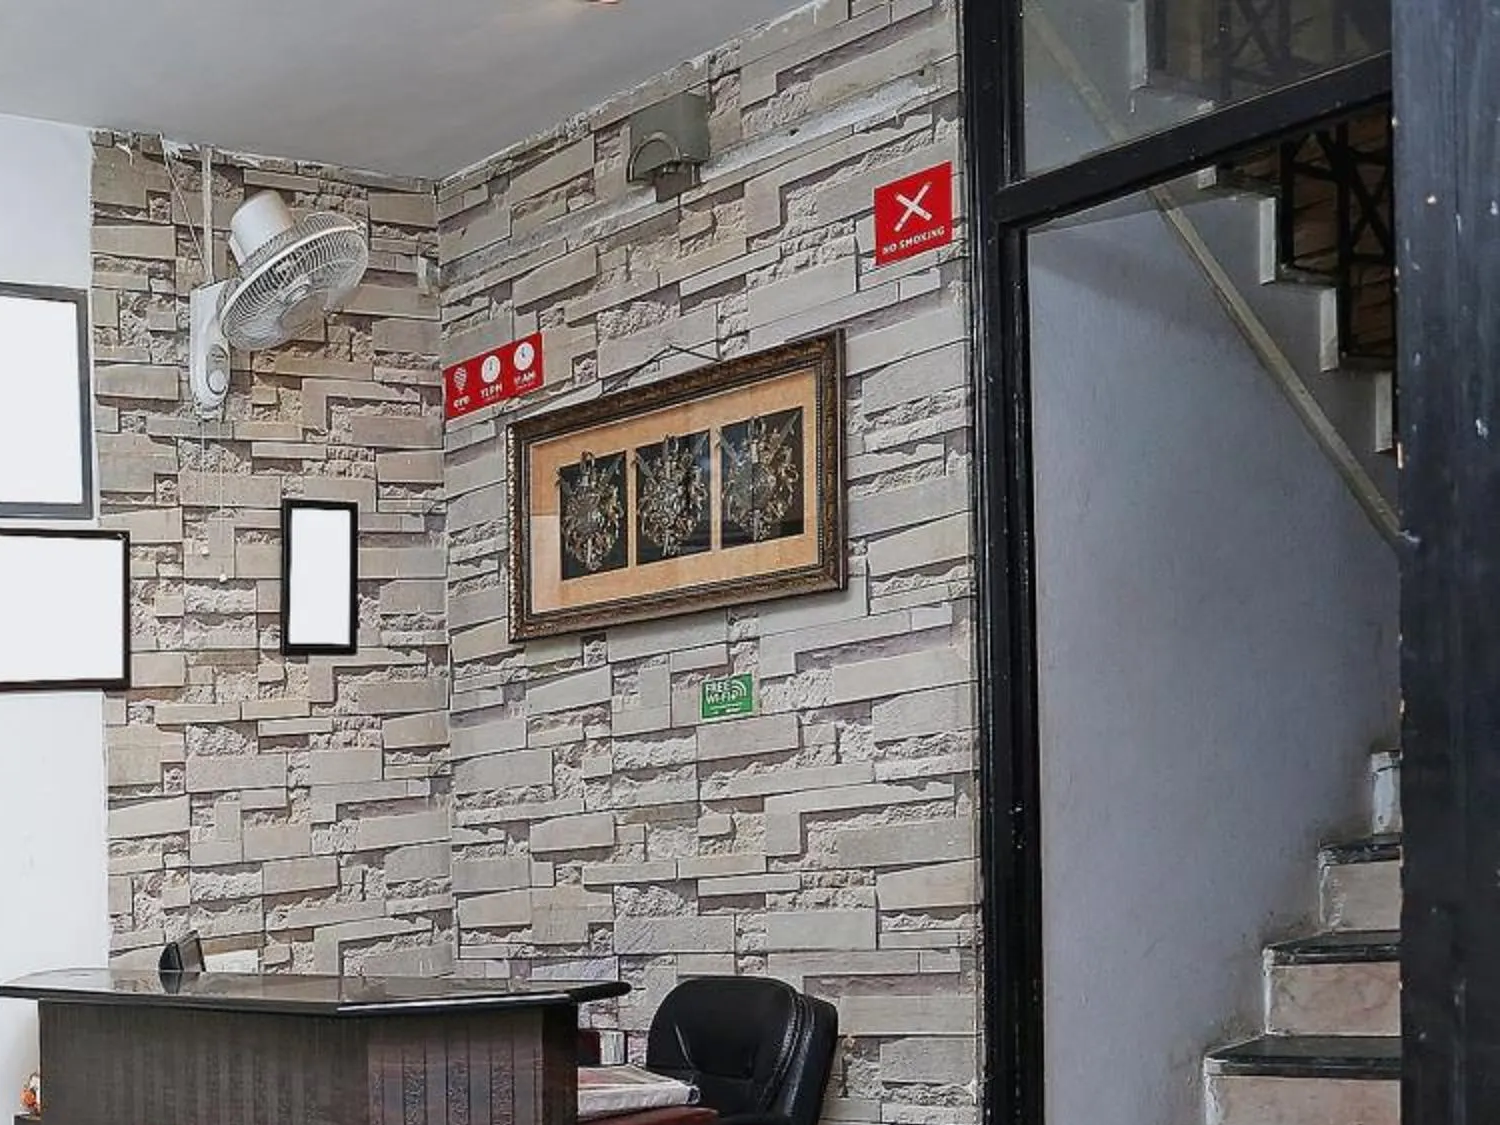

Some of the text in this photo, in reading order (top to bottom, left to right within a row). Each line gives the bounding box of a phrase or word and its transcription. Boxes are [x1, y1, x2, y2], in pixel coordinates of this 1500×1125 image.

[883, 226, 945, 255] NO SMOKING
[705, 680, 731, 693] FREE
